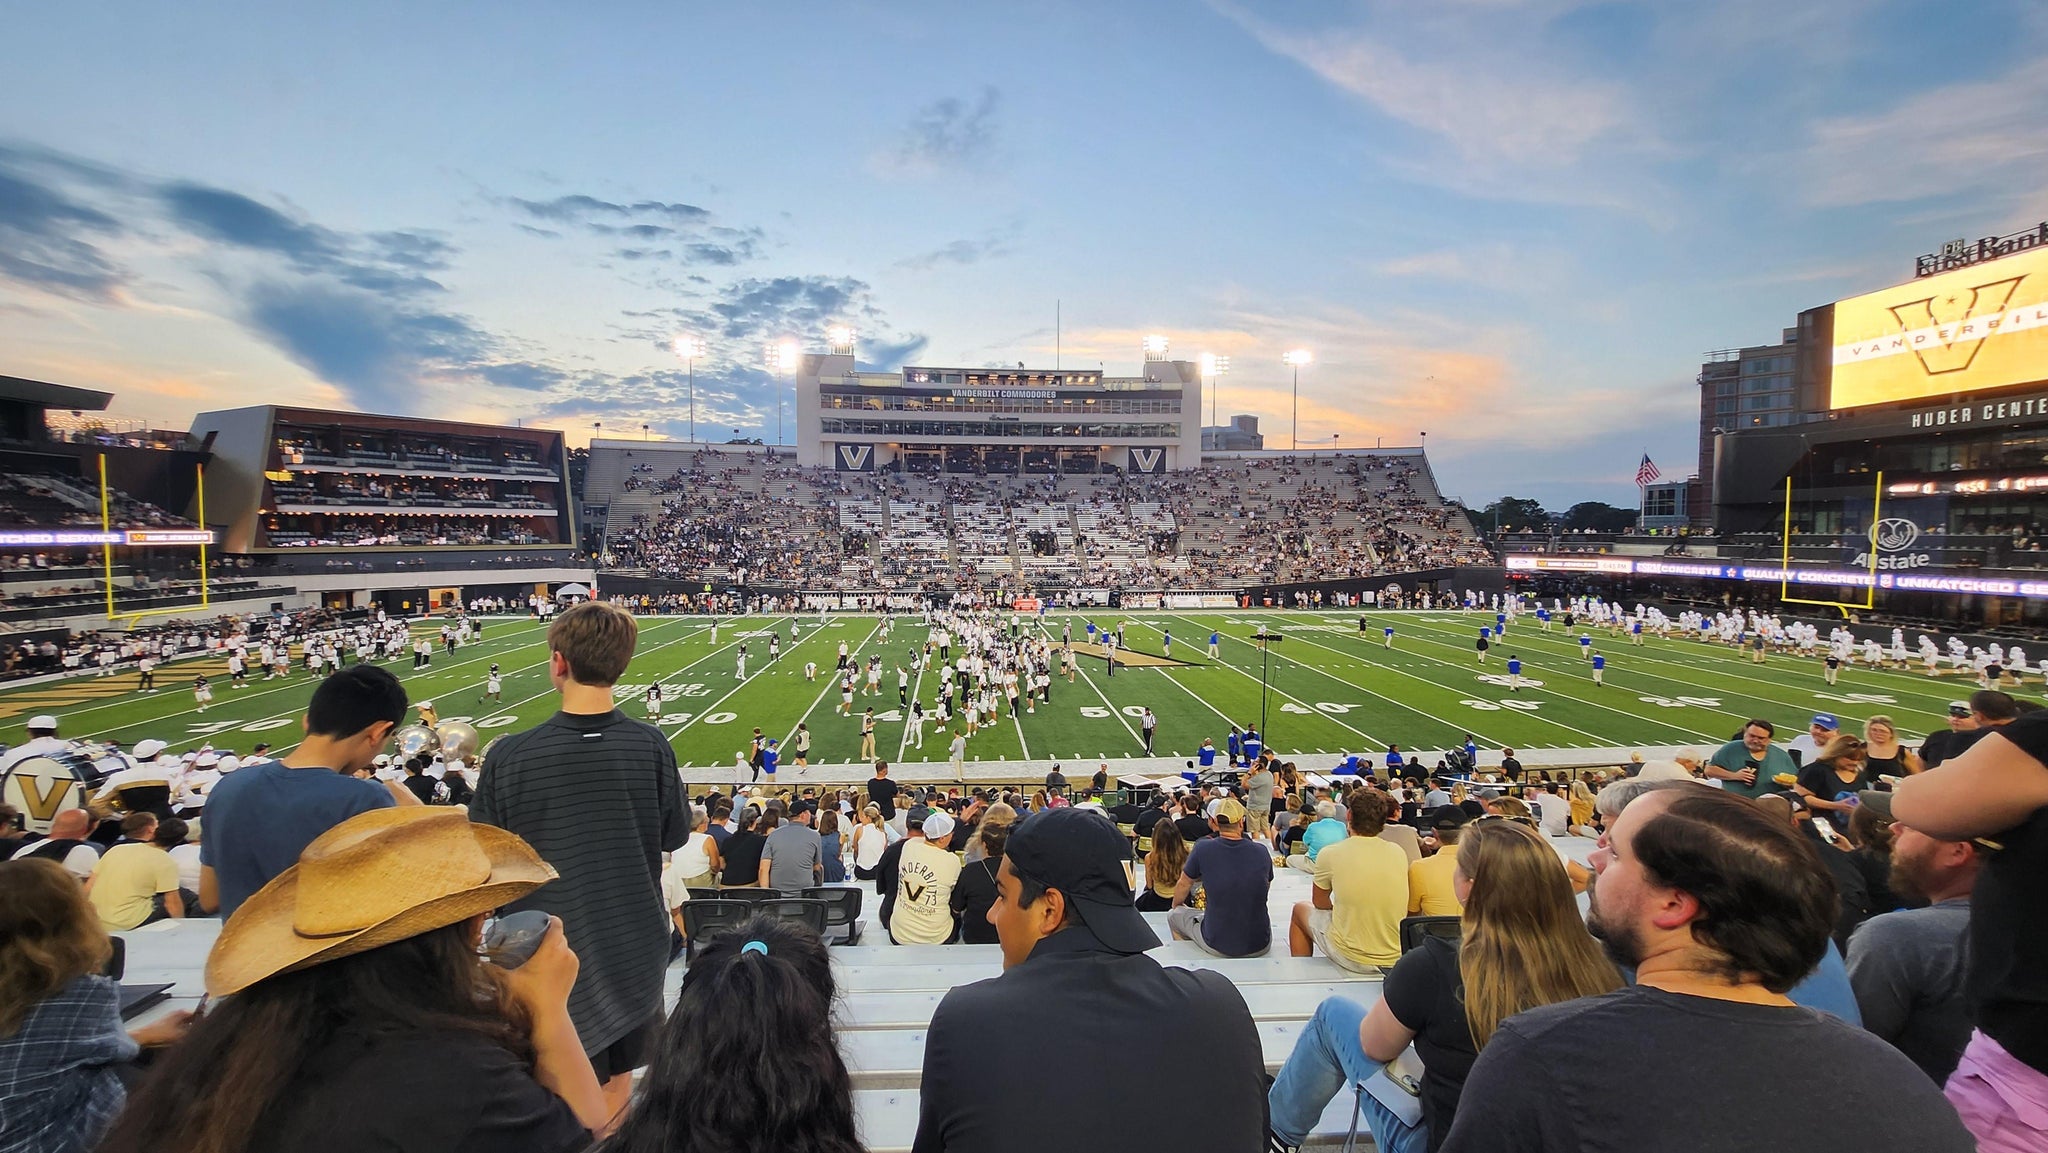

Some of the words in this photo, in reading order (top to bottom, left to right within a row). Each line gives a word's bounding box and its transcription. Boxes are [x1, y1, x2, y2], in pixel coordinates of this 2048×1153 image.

[1852, 310, 2048, 356] VANDERBIL
[952, 389, 999, 398] VANDERBILT
[1001, 390, 1056, 399] COMMODORES
[1912, 407, 1971, 428] HUBER
[1983, 398, 2048, 420] CENTE
[1851, 551, 1930, 570] Allstate
[1661, 565, 1721, 576] CONCRETE
[1742, 569, 1795, 581] QUALITY
[1797, 572, 1876, 586] CONCRETE
[1896, 577, 2016, 594] UNMATCHED
[1080, 705, 1147, 718] 50
[14, 773, 75, 821] V
